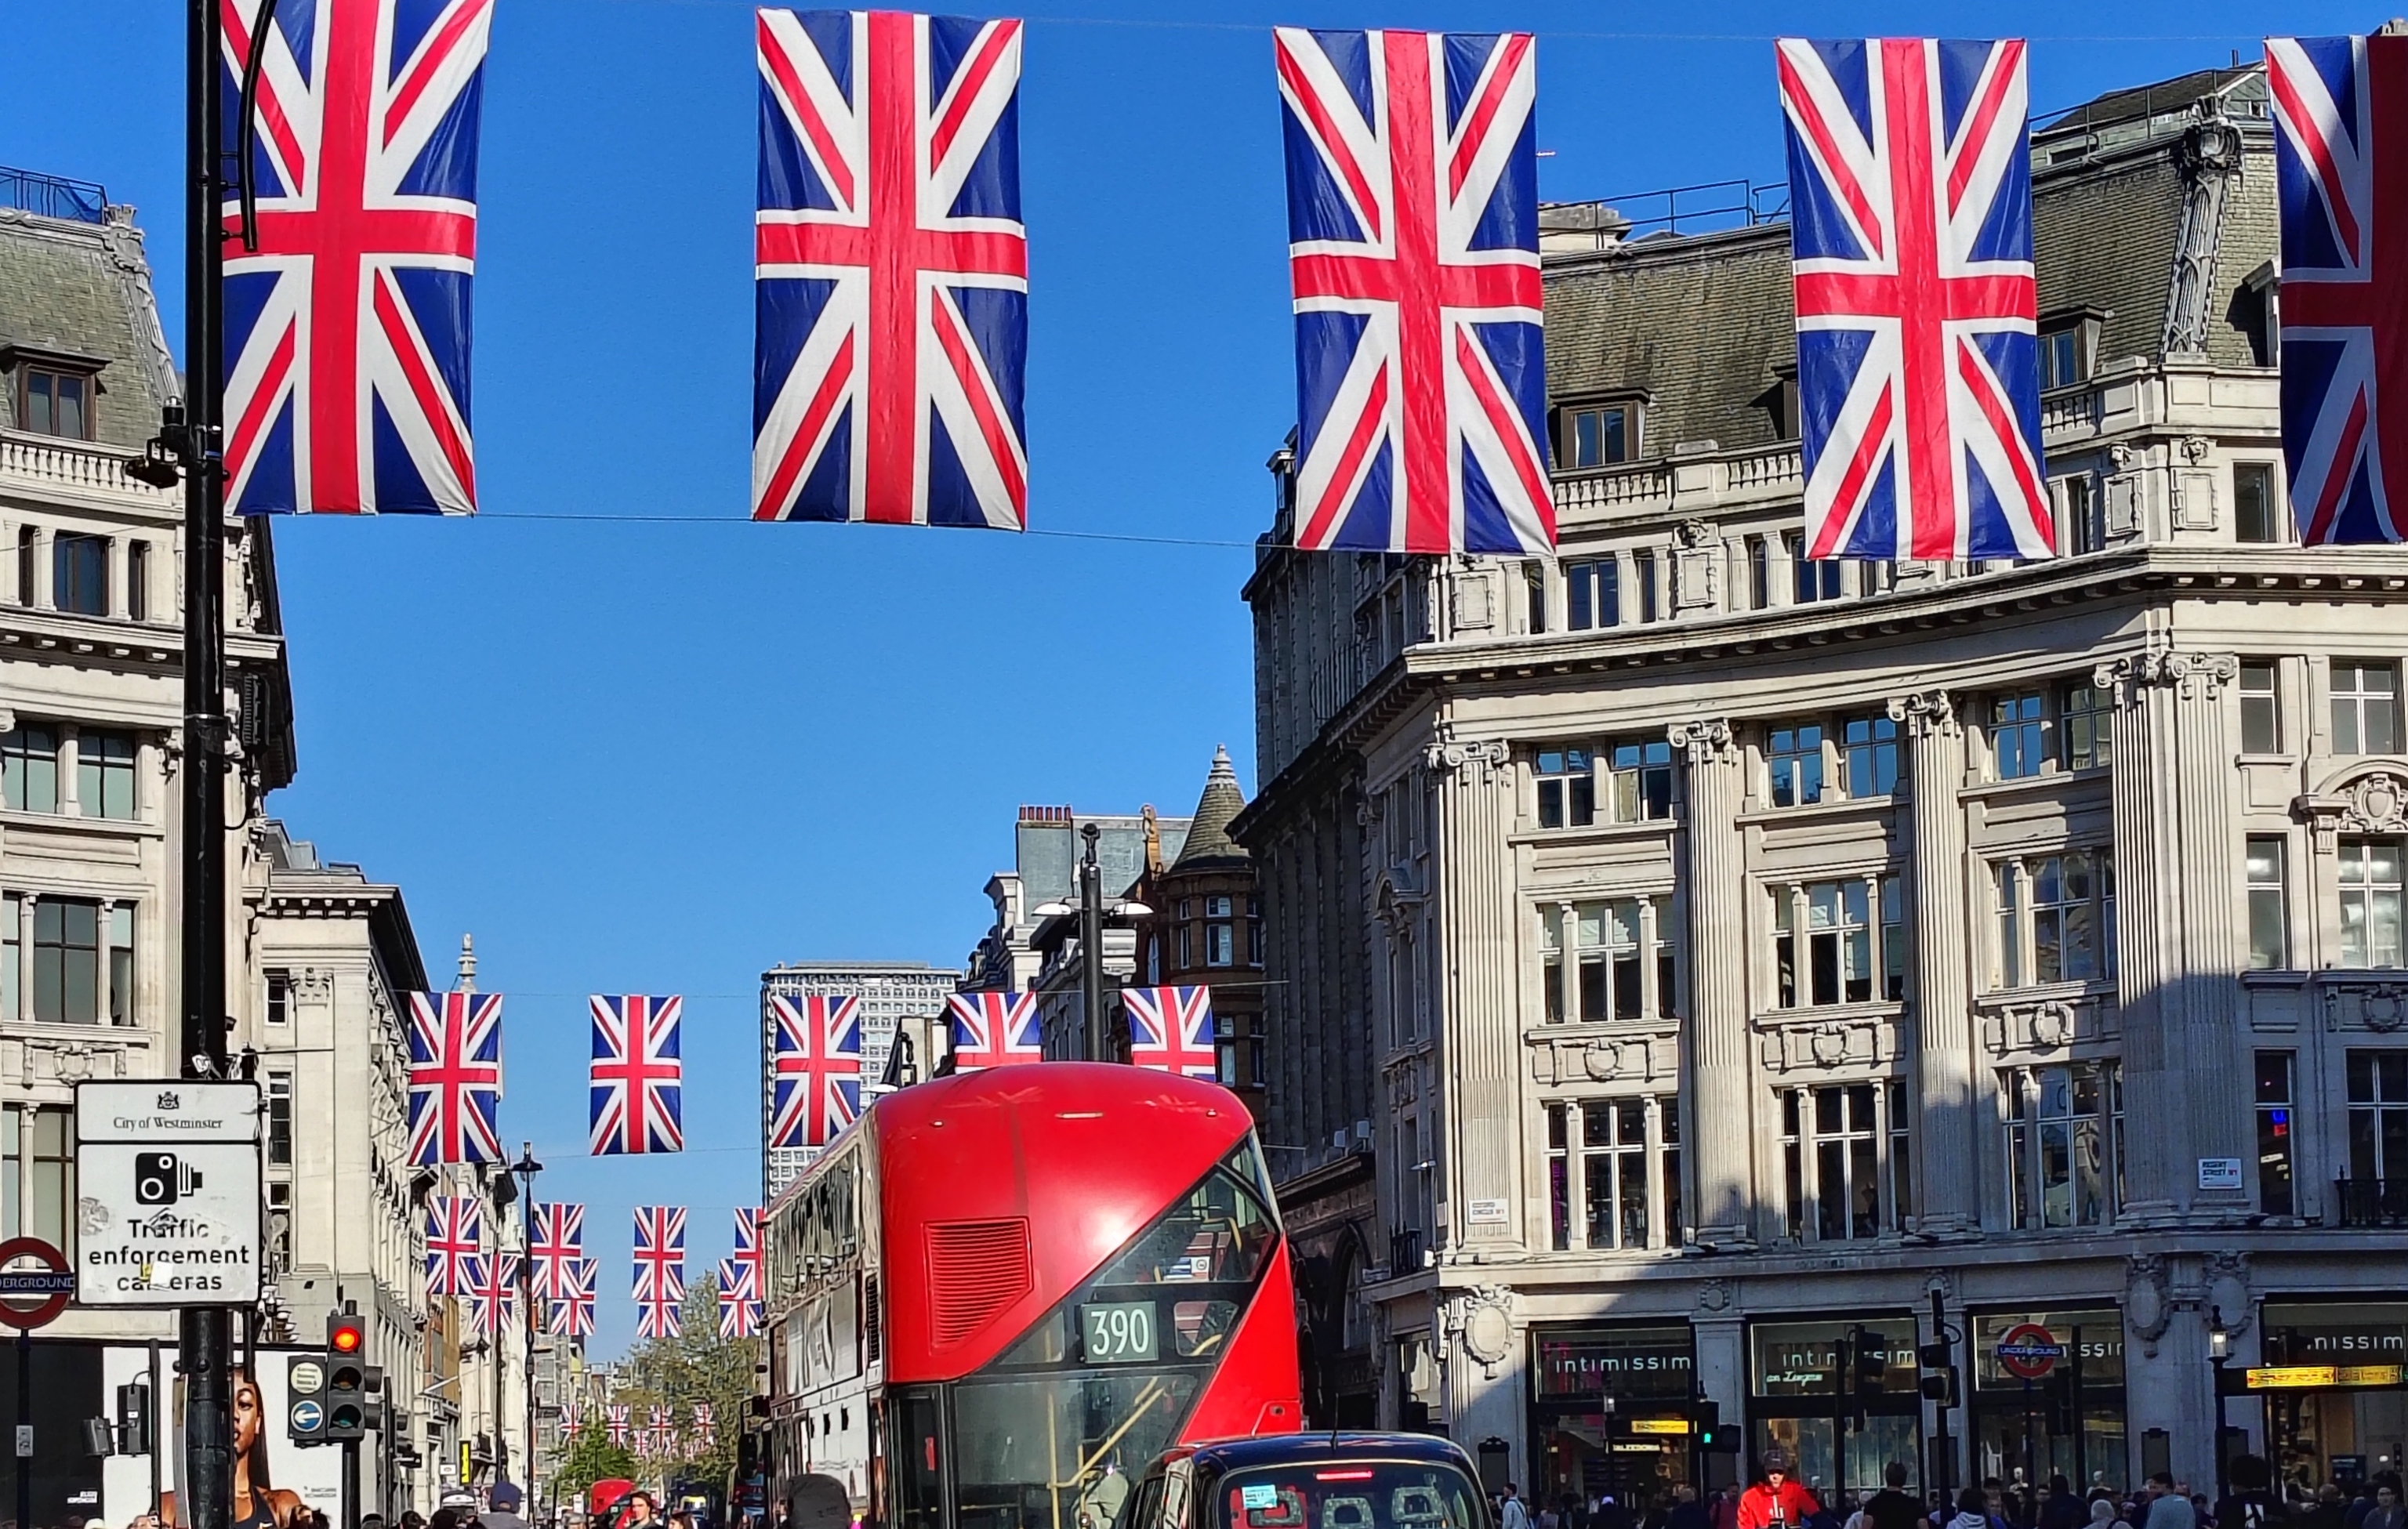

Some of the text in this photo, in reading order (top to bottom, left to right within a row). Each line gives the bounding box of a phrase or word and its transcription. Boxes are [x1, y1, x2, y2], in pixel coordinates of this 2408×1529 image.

[113, 1116, 223, 1132] City of Westminster
[89, 1245, 250, 1265] enforcement
[117, 1276, 223, 1292] caeras
[1090, 1308, 1149, 1356] 390
